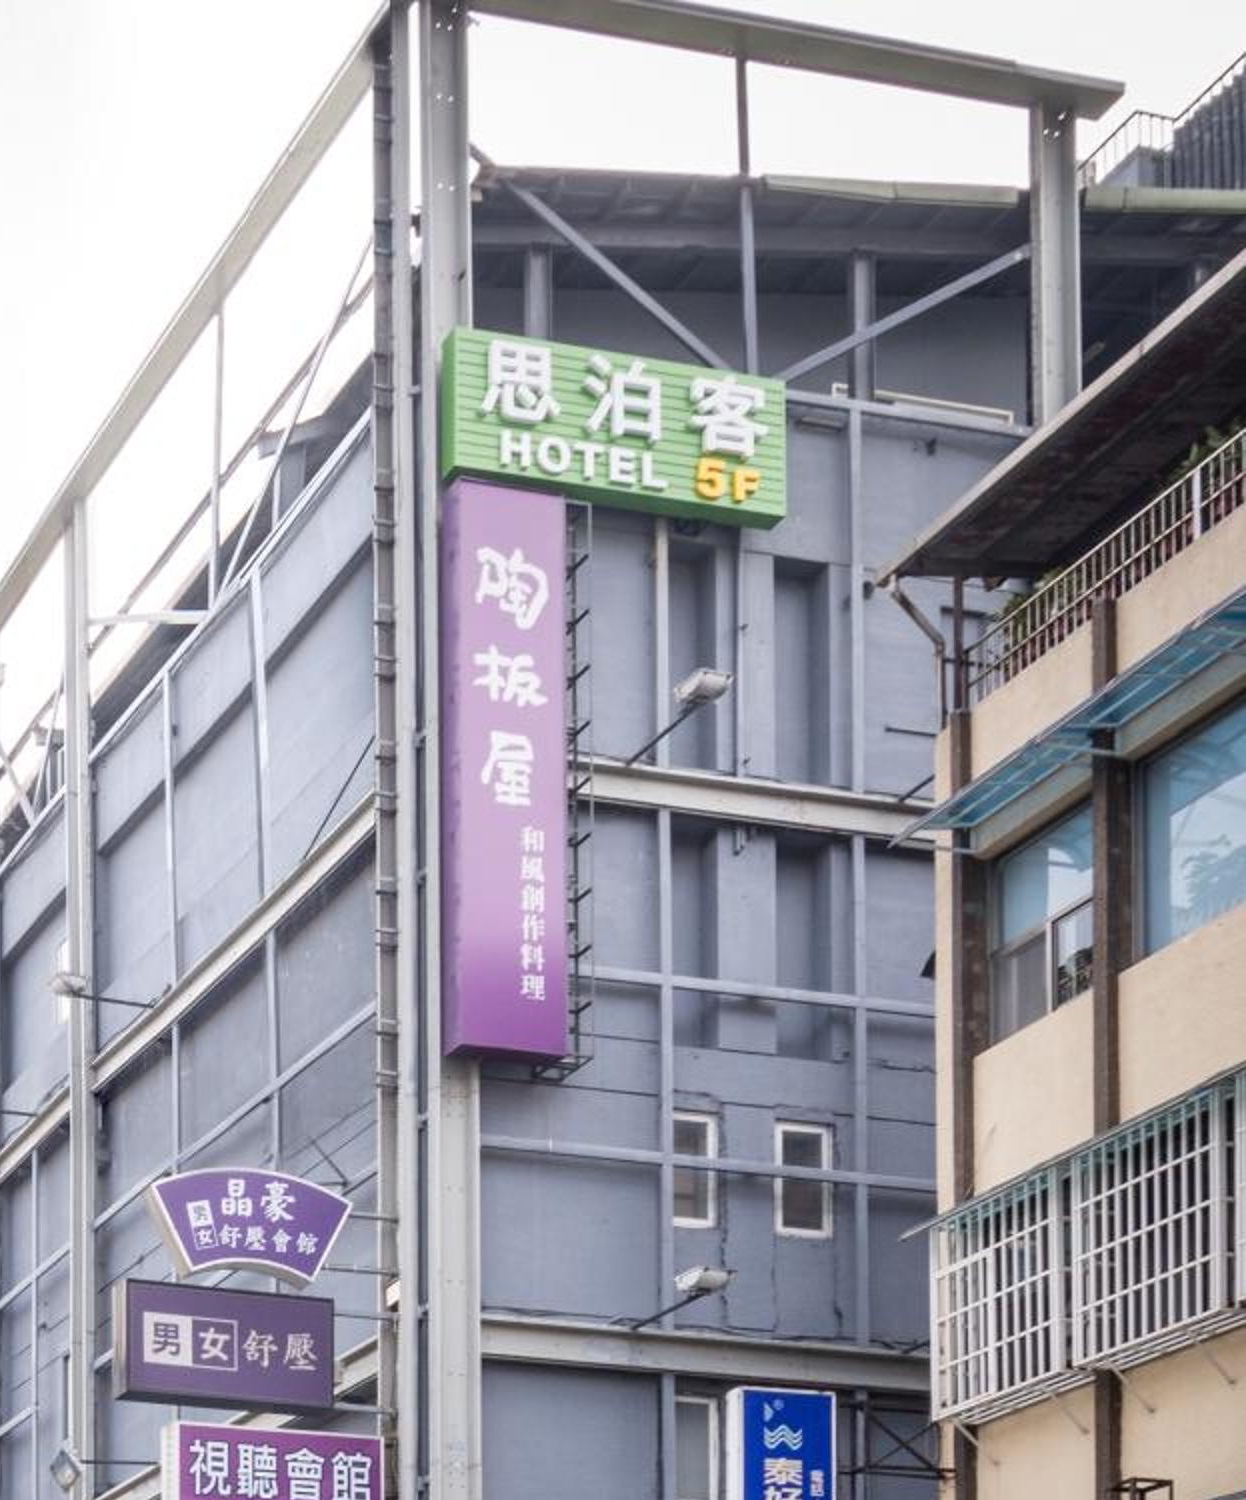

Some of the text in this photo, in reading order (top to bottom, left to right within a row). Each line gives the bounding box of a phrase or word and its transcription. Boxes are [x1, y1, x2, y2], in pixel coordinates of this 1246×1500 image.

[481, 340, 769, 456] 思泊客
[500, 430, 761, 502] HOTEL 5F
[474, 545, 549, 806] 陶板屋
[520, 825, 546, 1001] 和風創作料理
[221, 1179, 296, 1222] 晶豪
[152, 1322, 317, 1371] 男女舒壓
